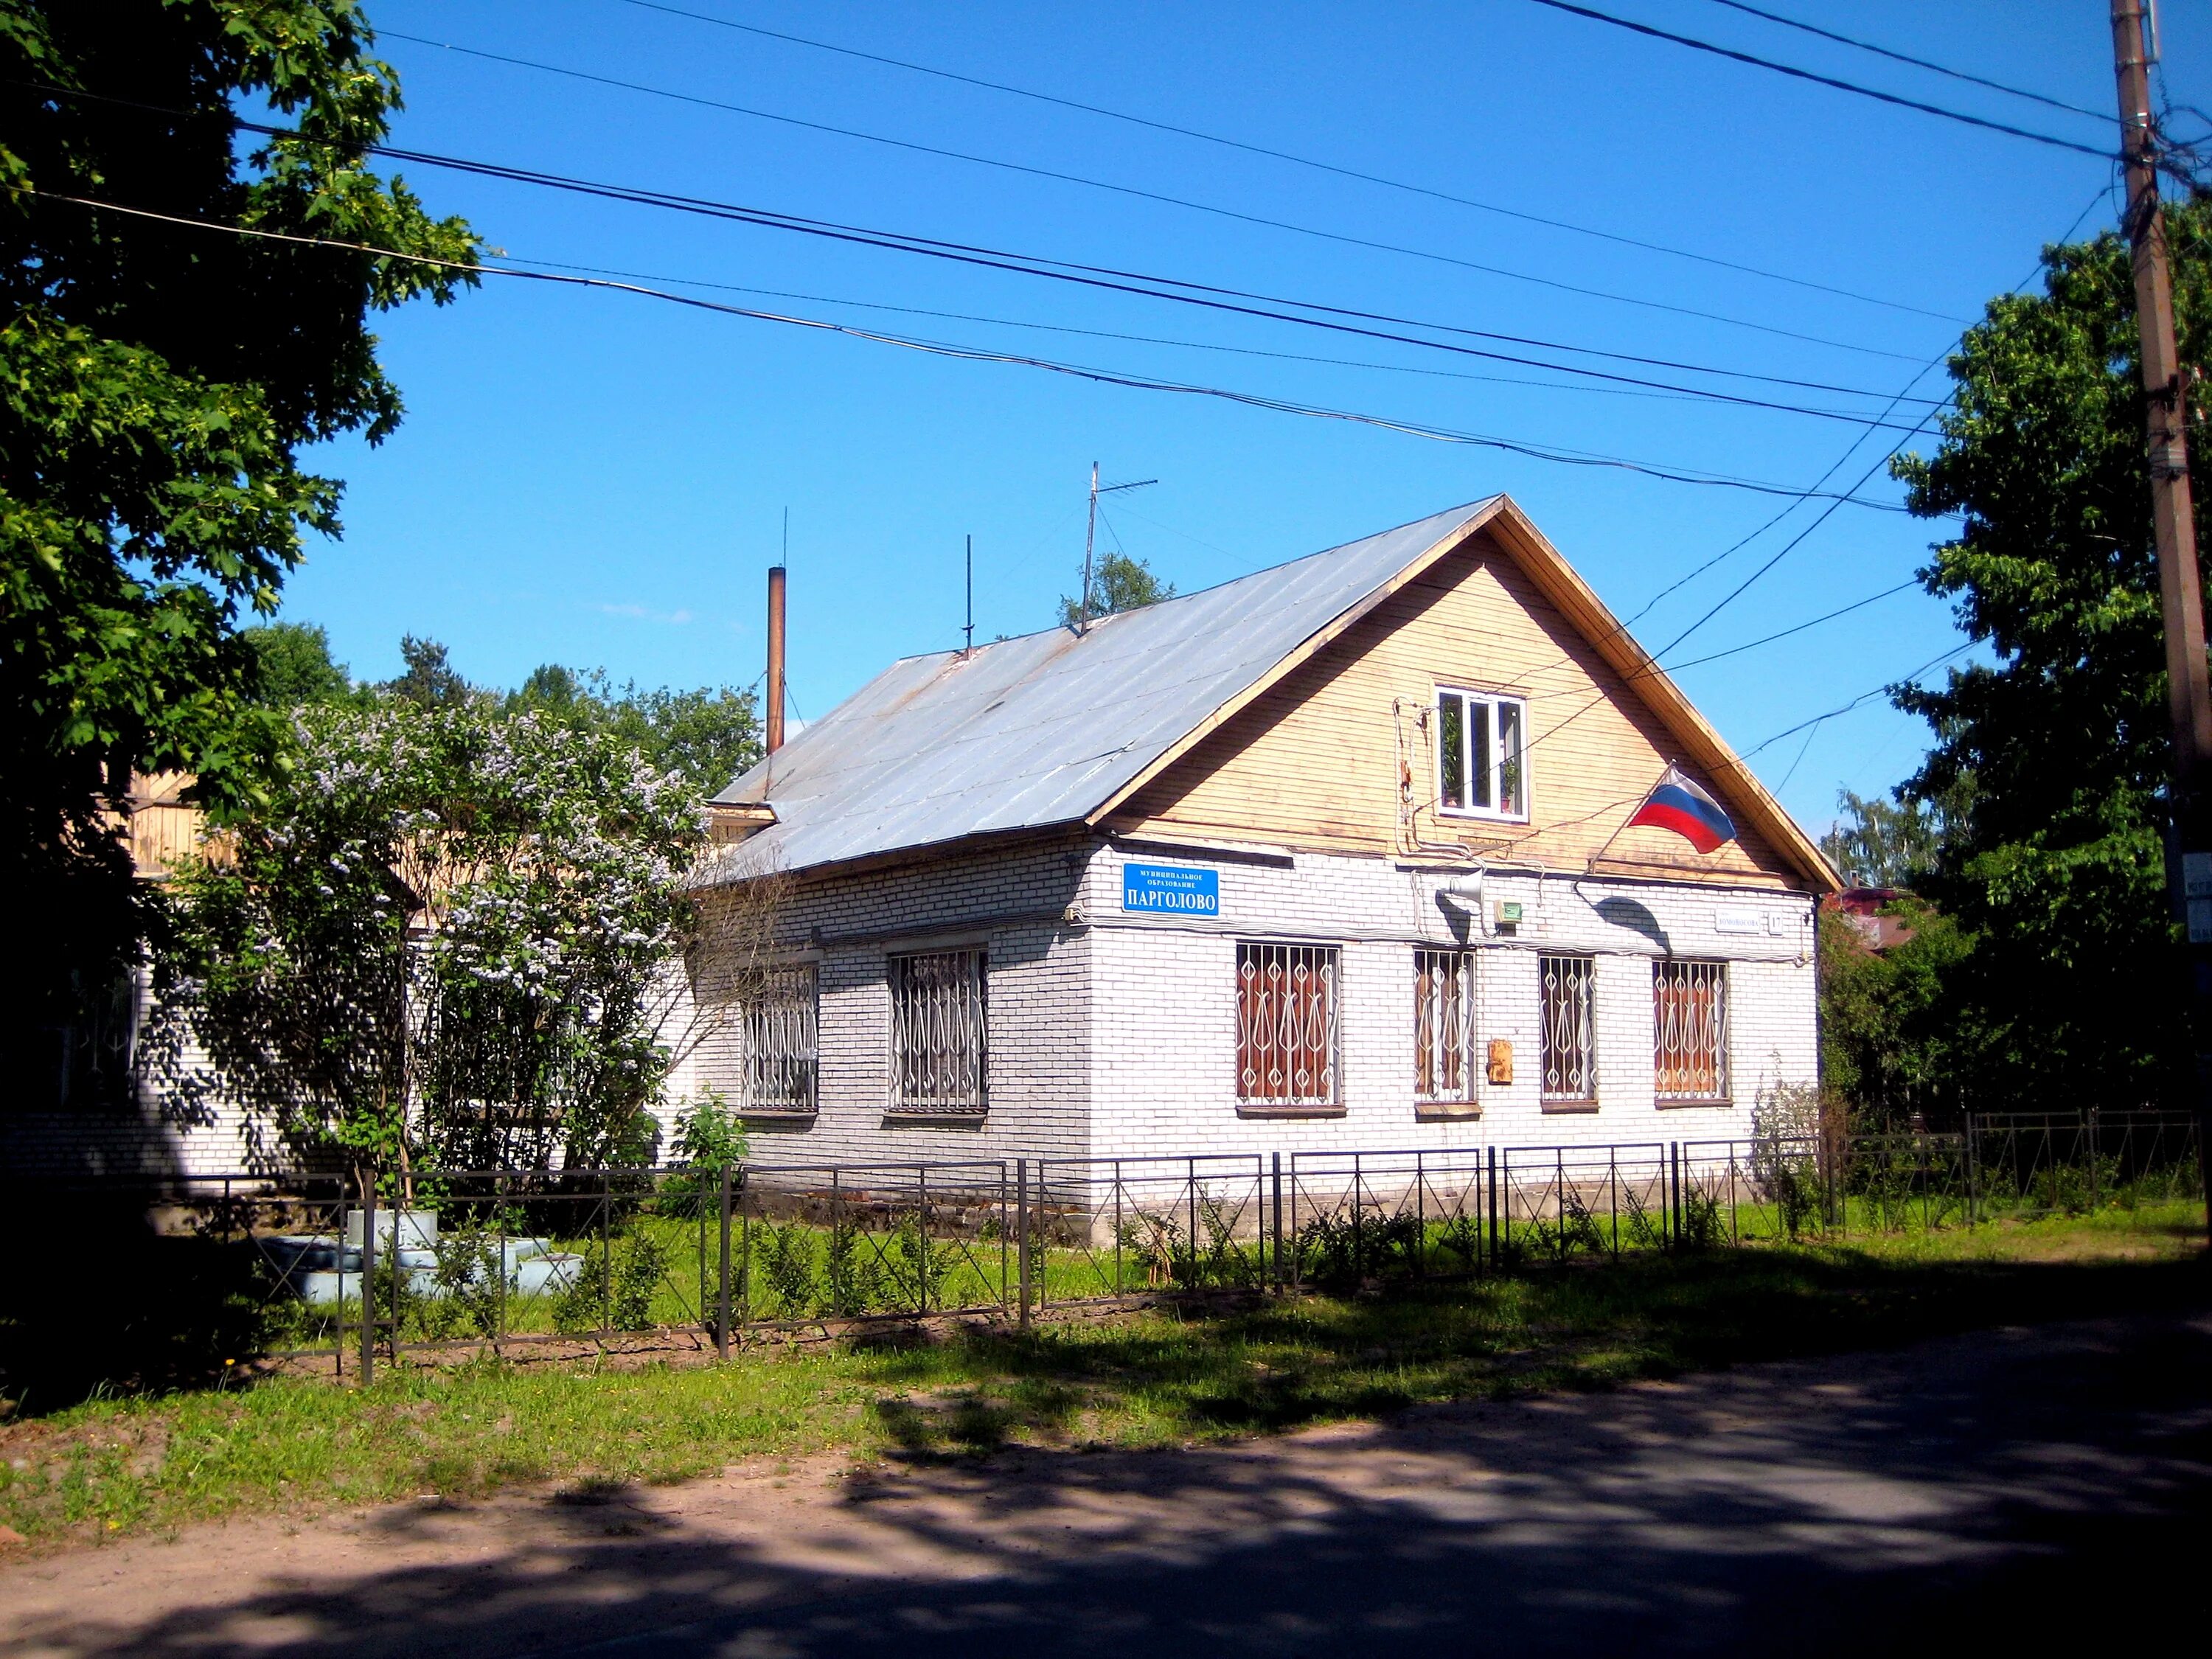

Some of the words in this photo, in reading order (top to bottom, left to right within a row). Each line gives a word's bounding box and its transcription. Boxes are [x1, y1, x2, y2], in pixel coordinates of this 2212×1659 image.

[1140, 869, 1203, 881] МУНИЦИПАЛЬНОЕ
[1147, 879, 1196, 888] ОБРАЗОВАНИЕ
[1127, 888, 1216, 911] ПАРГОЛОВО
[1772, 917, 1781, 928] 17
